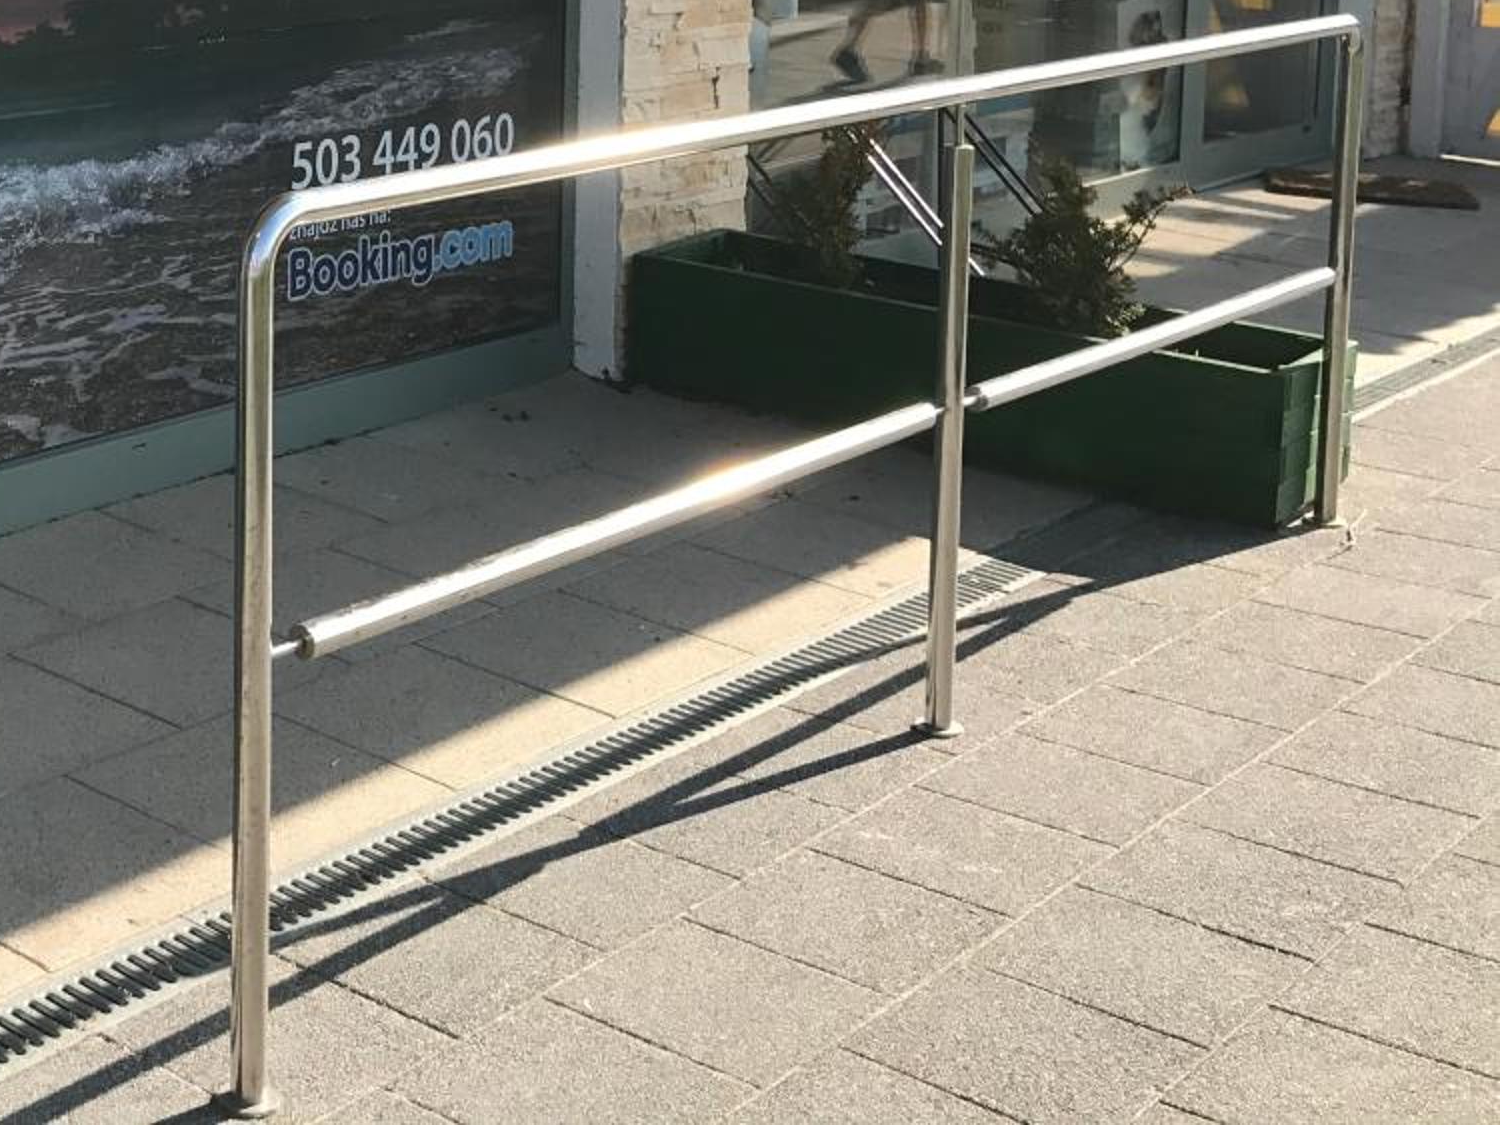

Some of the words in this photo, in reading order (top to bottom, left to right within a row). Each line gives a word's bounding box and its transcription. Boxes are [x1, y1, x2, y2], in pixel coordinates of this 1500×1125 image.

[291, 136, 362, 190] 503
[372, 123, 441, 175] 449
[451, 112, 514, 164] 060
[286, 219, 513, 301] Booking.com
